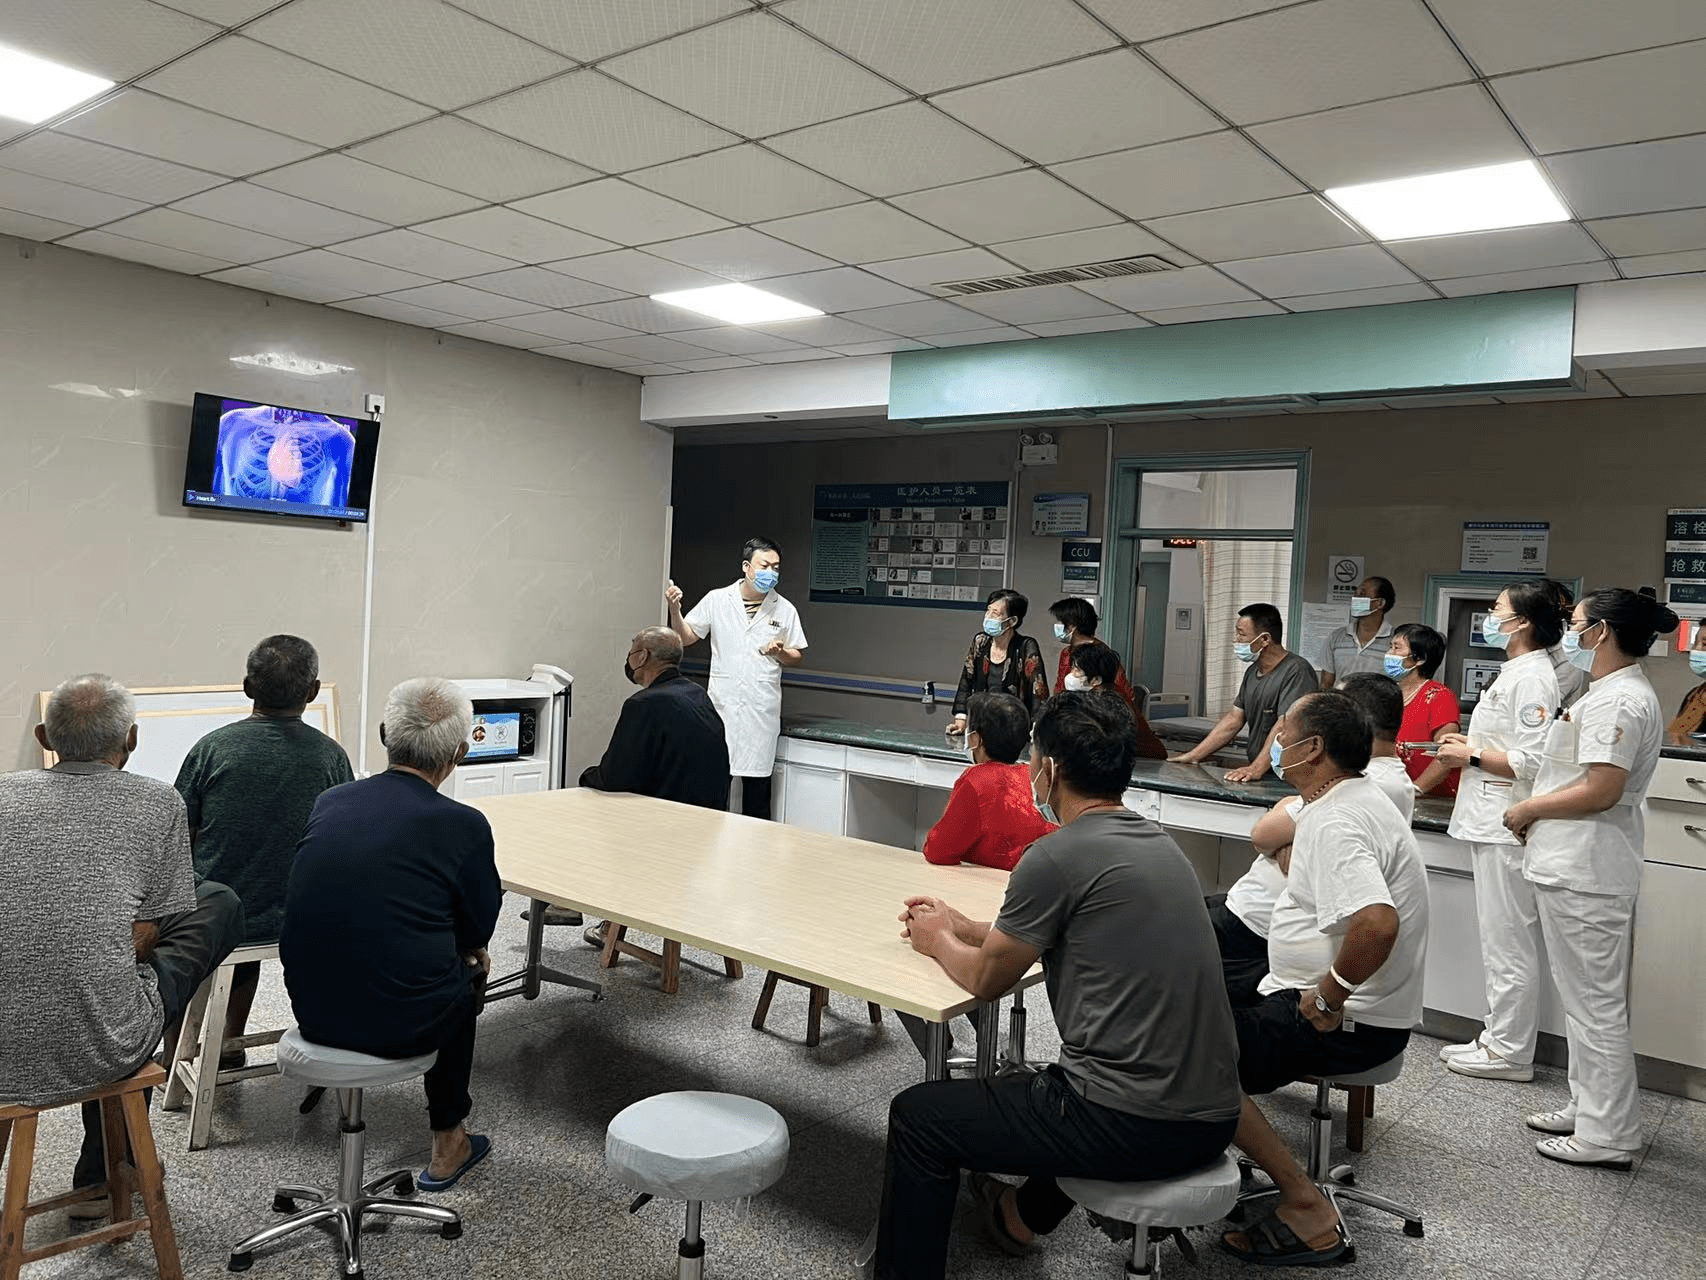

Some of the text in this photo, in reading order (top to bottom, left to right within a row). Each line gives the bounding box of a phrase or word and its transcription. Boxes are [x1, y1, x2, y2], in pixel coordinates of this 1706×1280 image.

[897, 486, 977, 496] 医护人员一览表
[1674, 521, 1706, 535] 溶栓
[1071, 548, 1090, 557] CCU
[1672, 559, 1706, 573] 抢救
